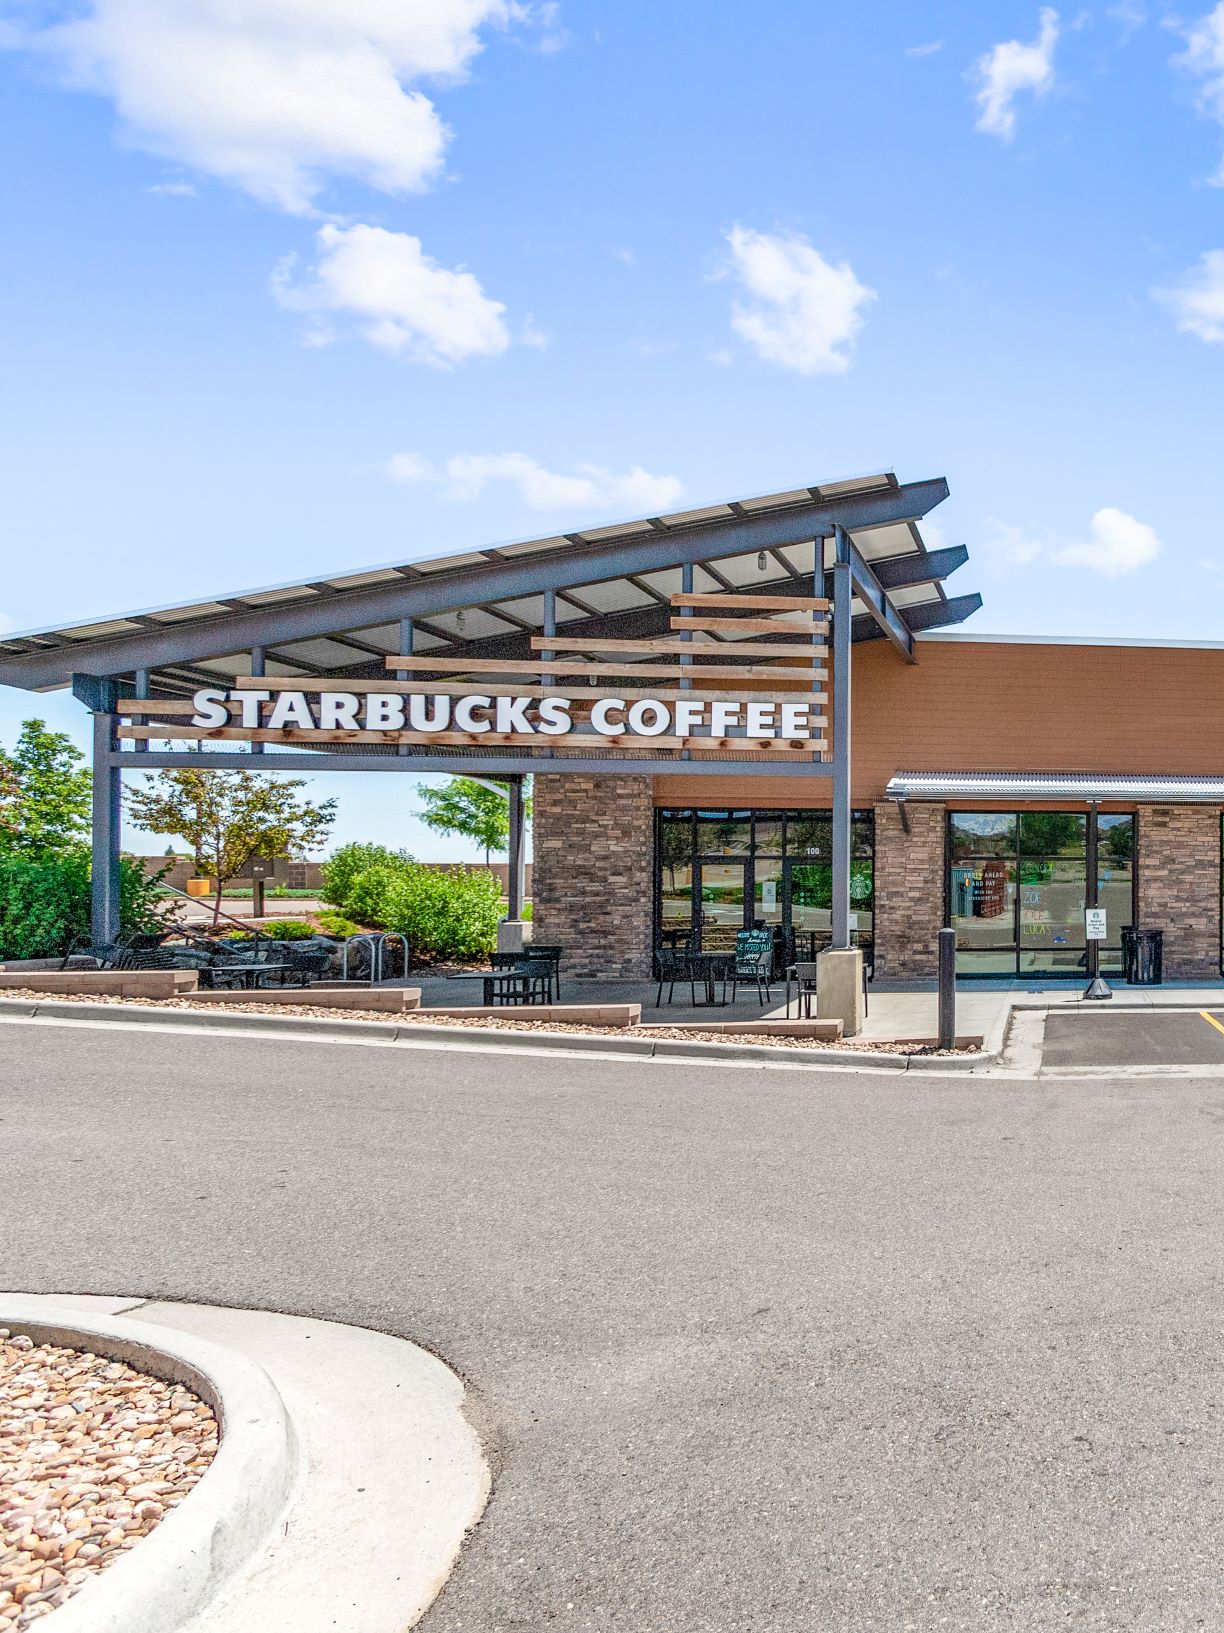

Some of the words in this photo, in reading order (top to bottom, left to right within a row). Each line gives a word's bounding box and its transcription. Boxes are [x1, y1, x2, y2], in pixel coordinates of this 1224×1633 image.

[191, 688, 573, 735] STARBUCKS
[590, 698, 810, 739] COFFEE
[806, 847, 820, 855] 100
[984, 871, 1004, 879] AHEAD
